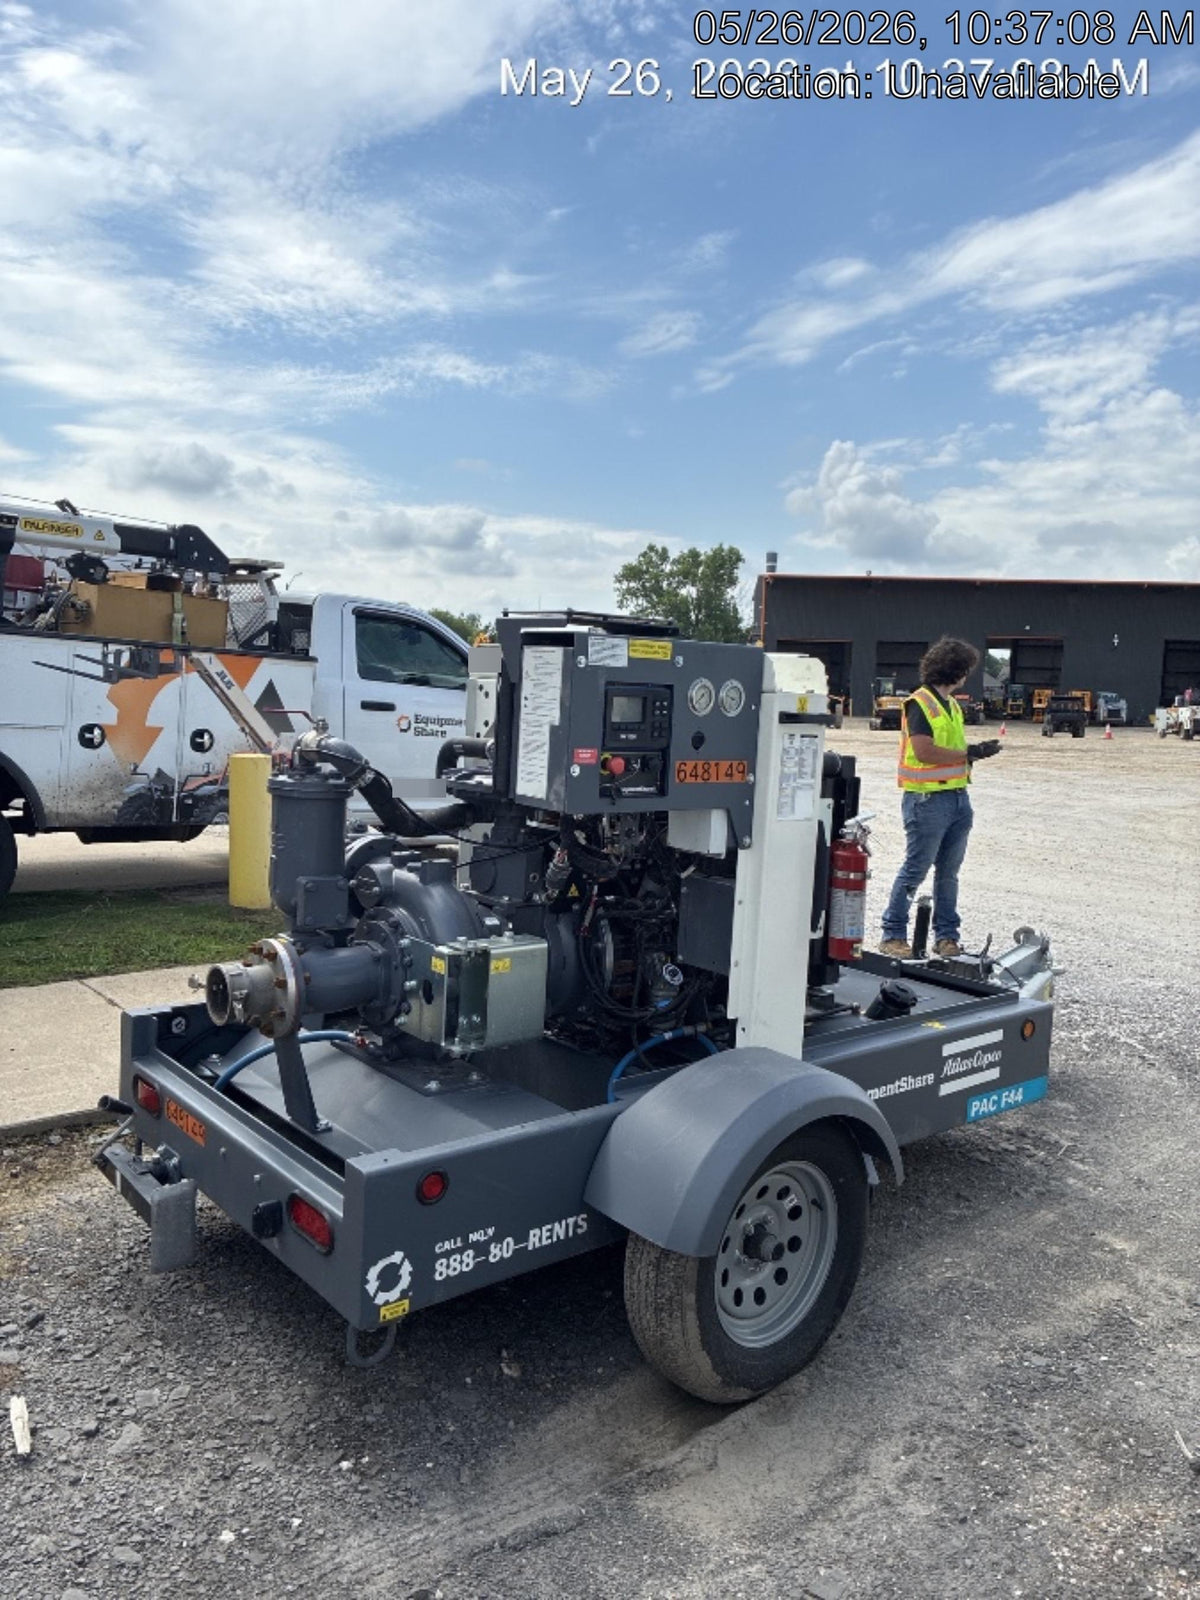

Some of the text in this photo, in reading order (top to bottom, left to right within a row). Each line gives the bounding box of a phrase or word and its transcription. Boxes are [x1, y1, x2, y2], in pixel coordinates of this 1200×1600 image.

[414, 713, 466, 727] Equipme
[414, 726, 447, 738] Share
[677, 761, 746, 783] 648149
[866, 1072, 935, 1101] mentShare
[970, 1087, 1024, 1118] PAC F44
[434, 1236, 462, 1254] CALL
[434, 1213, 588, 1281] 888-80-RENTS
